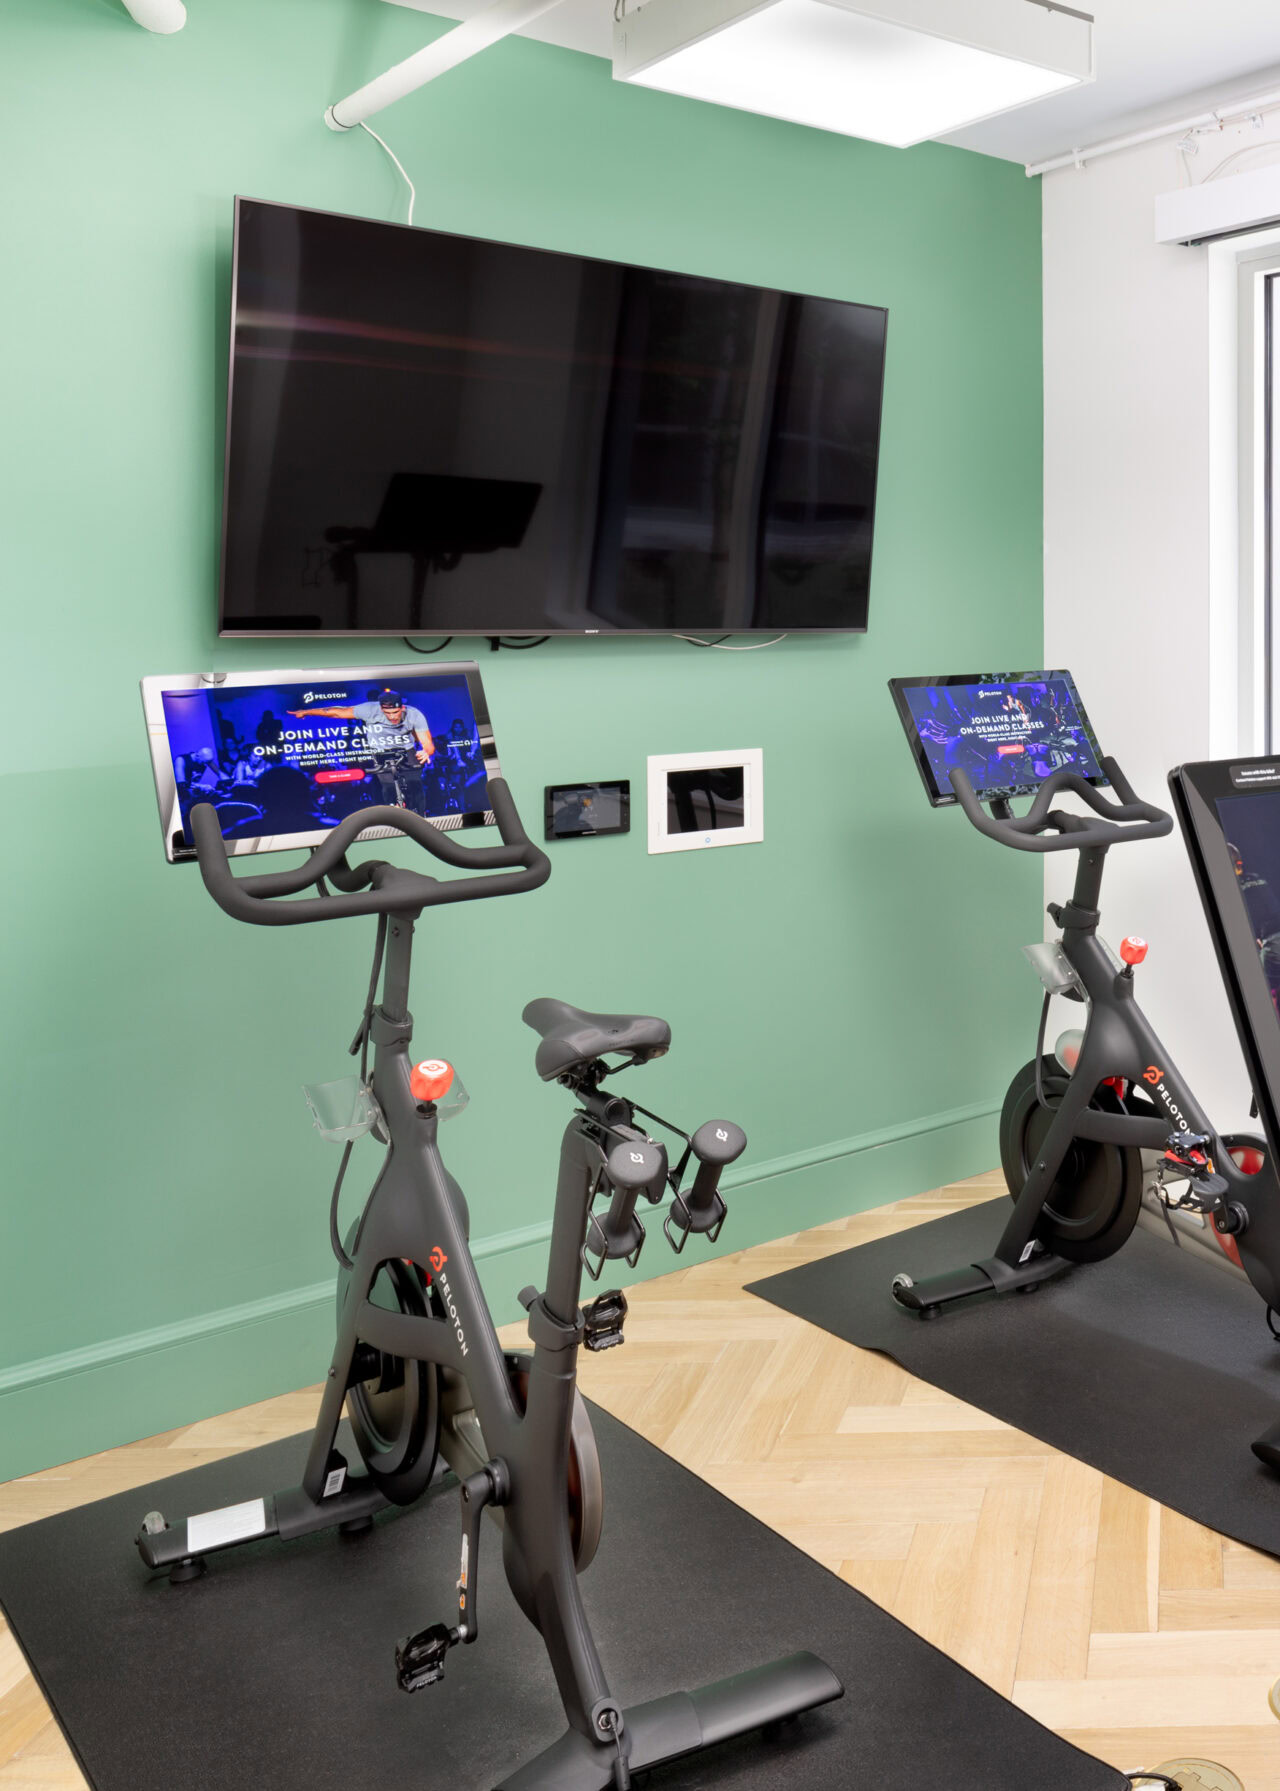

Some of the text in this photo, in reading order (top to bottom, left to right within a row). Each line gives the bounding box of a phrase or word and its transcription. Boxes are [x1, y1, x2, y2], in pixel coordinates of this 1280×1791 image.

[971, 716, 990, 724] JOIN
[992, 714, 1010, 723] LIVE
[278, 724, 383, 741] JOIN LIVE AND
[960, 721, 1044, 735] ON-DEMAND CLASSES
[253, 735, 411, 756] ON-DEMAND CLASSES
[440, 1272, 469, 1357] PELOTON
